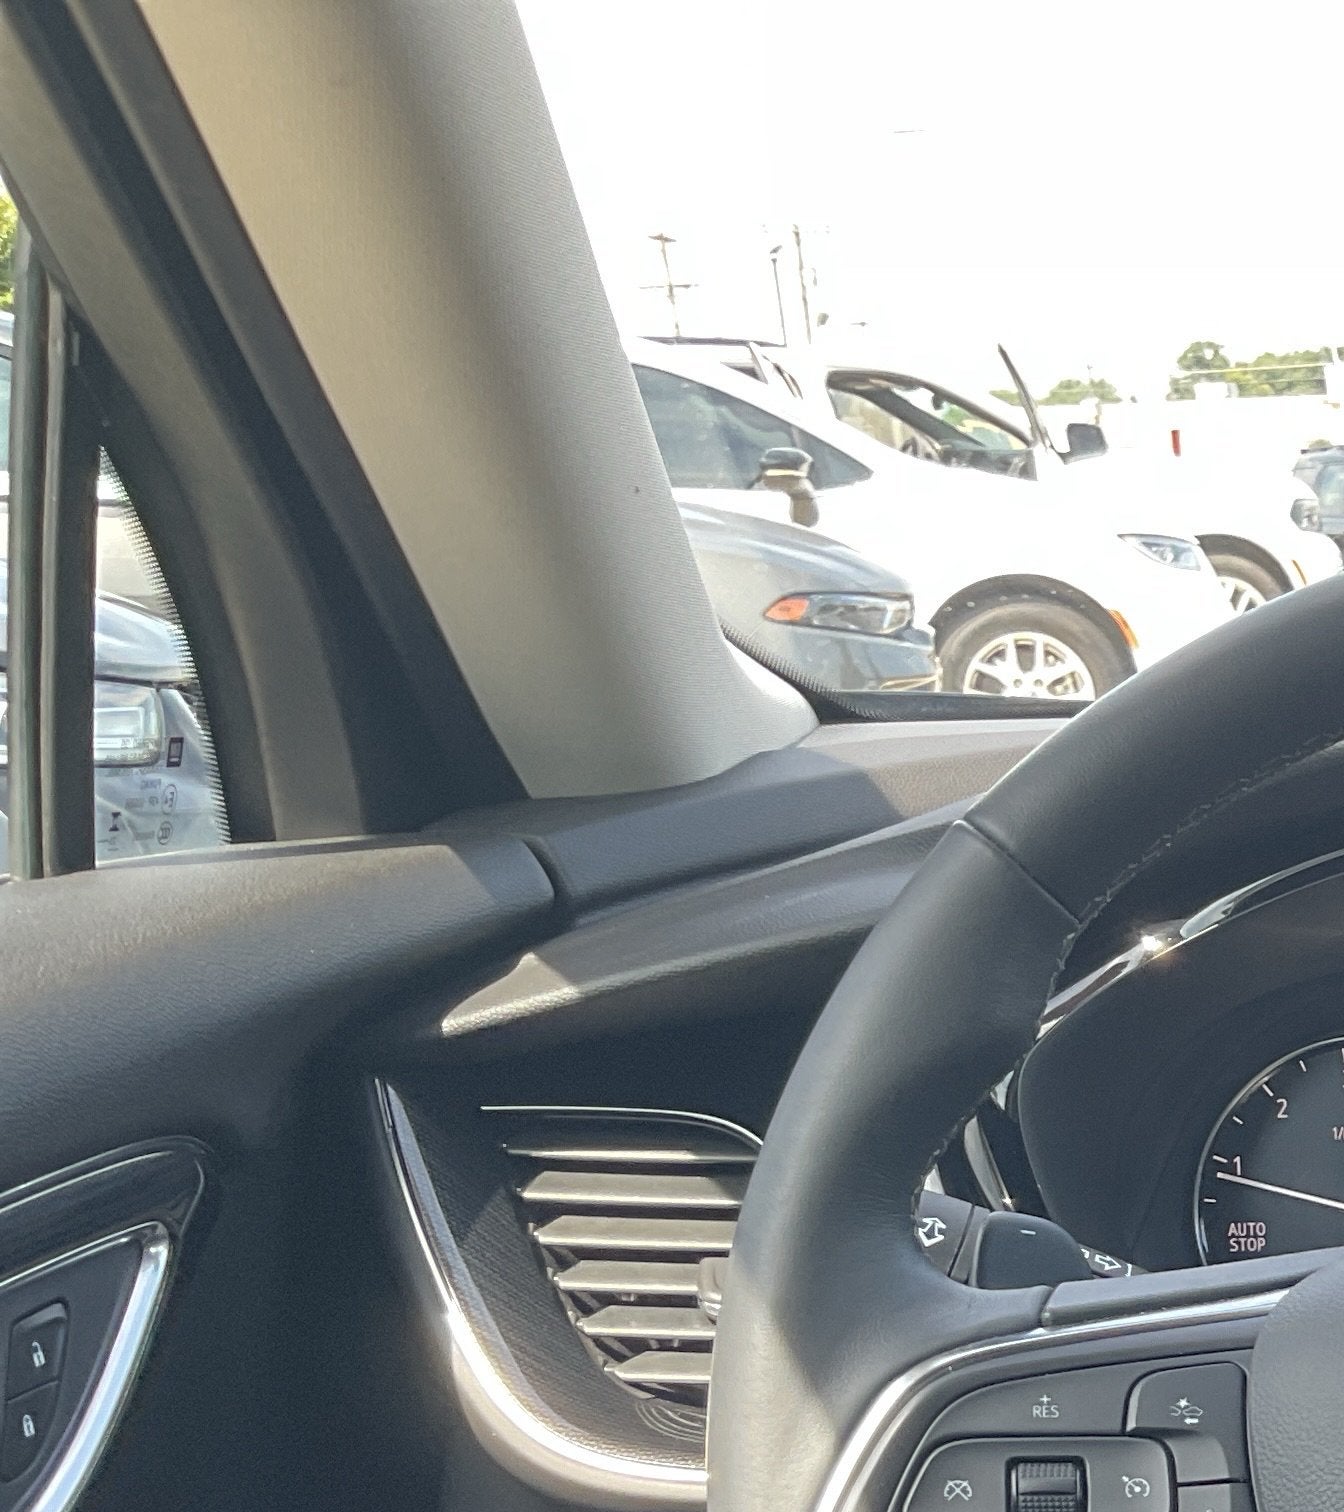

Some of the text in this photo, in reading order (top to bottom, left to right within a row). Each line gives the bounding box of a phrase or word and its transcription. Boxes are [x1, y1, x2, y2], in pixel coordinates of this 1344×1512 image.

[1276, 1098, 1289, 1119] 2
[1233, 1155, 1242, 1176] 1
[1227, 1221, 1266, 1237] AUTO
[1229, 1237, 1267, 1253] STOP
[1032, 1405, 1060, 1419] RES
